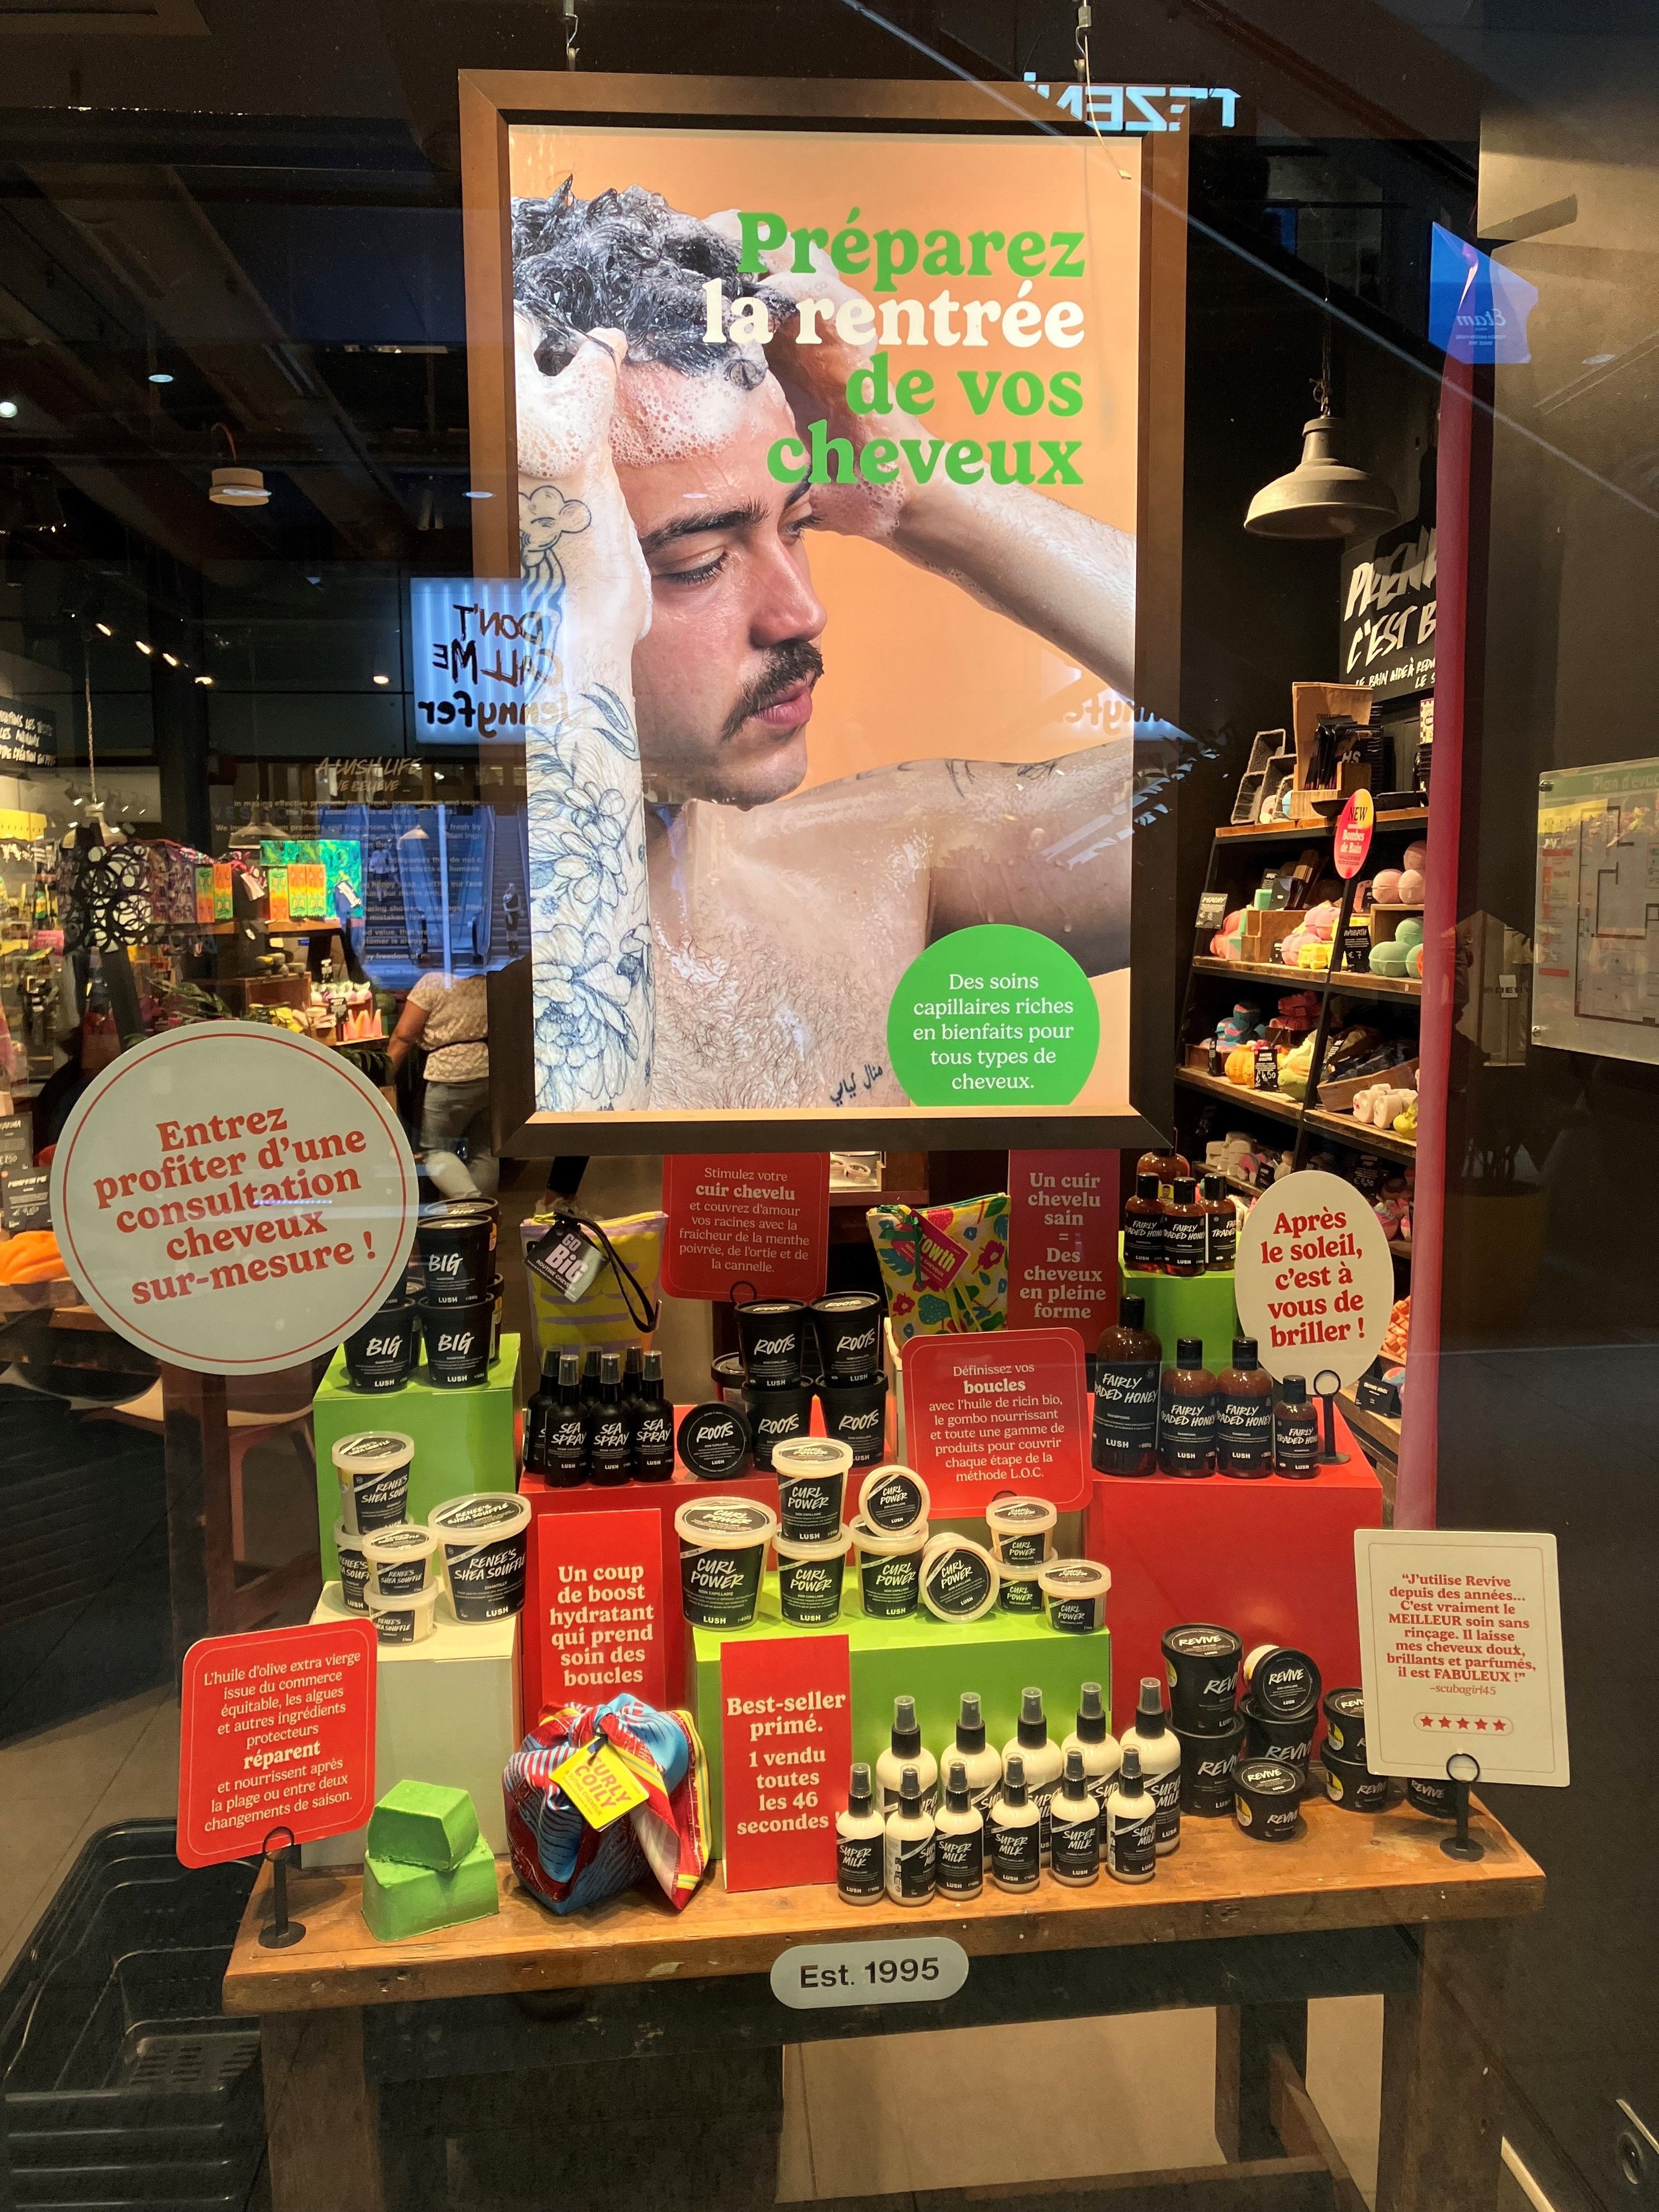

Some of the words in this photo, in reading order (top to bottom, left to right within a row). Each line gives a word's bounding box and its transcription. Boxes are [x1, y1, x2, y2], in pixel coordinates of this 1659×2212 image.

[737, 207, 1085, 292] Préparez
[702, 278, 774, 344] la
[796, 280, 1084, 347] rentrée
[846, 351, 935, 415] de
[957, 371, 1084, 416] vos
[767, 420, 1084, 484] cheveux
[1347, 606, 1418, 674] C'EST
[1348, 807, 1368, 821] NEW
[1342, 829, 1365, 842] Bombes
[1341, 842, 1348, 853] de
[1348, 842, 1362, 854] Bain
[949, 974, 984, 990] Des
[990, 973, 1039, 989] soins
[913, 998, 1010, 1019] capillaires
[1016, 997, 1074, 1014] riches
[913, 1028, 936, 1040] en
[942, 1023, 1023, 1040] bienfaits
[1029, 1025, 1074, 1043] pour
[931, 1050, 972, 1065] tous
[978, 1049, 1028, 1068] types
[1034, 1048, 1056, 1063] de
[952, 1074, 1034, 1090] cheveux.
[156, 1108, 287, 1152] Entrez
[93, 1153, 246, 1209] profiter
[258, 1131, 366, 1170] d'une
[705, 1168, 754, 1180] Stimulez
[758, 1172, 788, 1181] votre
[1030, 1173, 1056, 1188] Un
[1061, 1173, 1100, 1189] cuir
[696, 1183, 729, 1197] cuir
[734, 1185, 795, 1200] chevelu
[1027, 1192, 1101, 1208] chevelu
[117, 1168, 361, 1233] consultation
[704, 1205, 749, 1213] couvrez
[753, 1205, 801, 1216] d'amour
[1044, 1210, 1084, 1225] sain
[1273, 1206, 1347, 1238] Après
[167, 1210, 327, 1260] cheveux
[562, 1233, 582, 1252] GO
[1046, 1248, 1081, 1262] Des
[1261, 1242, 1283, 1264] le
[1290, 1233, 1362, 1261] soleil,
[428, 1252, 463, 1276] BIG
[712, 1259, 721, 1269] la
[725, 1261, 775, 1272] cannelle.
[131, 1243, 354, 1304] sur-mesure
[1024, 1266, 1103, 1282] cheveux
[1275, 1267, 1331, 1290] c'est
[1338, 1261, 1353, 1284] à
[1020, 1287, 1042, 1299] en
[1048, 1286, 1106, 1302] pleine
[1033, 1303, 1091, 1319] forme
[1267, 1297, 1327, 1319] vous
[1334, 1290, 1364, 1313] de
[836, 1328, 875, 1353] ROOTS
[1270, 1319, 1351, 1348] briller
[366, 1335, 403, 1357] BIG
[753, 1334, 796, 1355] ROOTS
[953, 1365, 1012, 1376] Définissez
[1015, 1364, 1035, 1373] vos
[963, 1378, 1026, 1394] boucles
[1103, 1373, 1142, 1389] FAIRLY
[929, 1402, 955, 1411] avec
[958, 1399, 992, 1410] l'huile
[995, 1398, 1009, 1407] de
[1013, 1396, 1038, 1406] ricin
[1042, 1395, 1062, 1405] bio,
[1124, 1389, 1158, 1404] HONEY
[559, 1422, 581, 1434] SEA
[551, 1431, 587, 1446] SPRAY
[1106, 1439, 1129, 1448] LUSH
[956, 1469, 1007, 1482] méthode
[1011, 1468, 1044, 1479] L.O.C.
[791, 1487, 823, 1499] CURL
[788, 1497, 830, 1510] POWER
[469, 1548, 517, 1570] RENEE'S
[697, 1558, 737, 1573] CURL
[454, 1567, 484, 1581] SHEA
[558, 1566, 587, 1583] Un
[593, 1566, 644, 1583] coup
[690, 1573, 745, 1589] POWER
[1465, 1576, 1511, 1587] Revive
[557, 1586, 582, 1604] de
[588, 1584, 645, 1602] boost
[1389, 1587, 1433, 1599] depuis
[1437, 1589, 1460, 1598] des
[550, 1605, 655, 1628] hydratant
[703, 1616, 726, 1624] LUSH
[1389, 1613, 1462, 1626] MEILLEUR
[1465, 1617, 1494, 1627] soin
[1498, 1619, 1529, 1628] sans
[551, 1627, 585, 1650] qui
[591, 1624, 653, 1647] prend
[1179, 1634, 1222, 1646] REVIVE
[561, 1648, 605, 1666] soin
[610, 1646, 645, 1663] des
[203, 1669, 245, 1686] L'huile
[248, 1663, 286, 1678] d'olive
[290, 1658, 322, 1672] extra
[325, 1652, 361, 1667] vierge
[564, 1667, 643, 1687] boucles
[1268, 1668, 1304, 1685] REVIVE
[1398, 1667, 1407, 1677] il
[1411, 1669, 1430, 1678] est
[1434, 1669, 1510, 1682] FABULEUX
[727, 1691, 846, 1716] Best-seller
[750, 1713, 823, 1742] primé.
[243, 1741, 321, 1770] réparent
[749, 1751, 758, 1767] 1
[763, 1747, 826, 1766] vendu
[587, 1756, 631, 1802] URLY
[756, 1772, 820, 1789] toutes
[759, 1793, 787, 1811] les
[792, 1792, 818, 1809] 46
[204, 1805, 290, 1833] changements
[294, 1799, 308, 1811] de
[312, 1792, 352, 1808] saison.
[737, 1815, 829, 1835] secondes
[995, 1833, 1029, 1850] SUPER
[998, 1843, 1024, 1857] MILK
[1003, 1874, 1019, 1882] LUSH
[800, 1964, 855, 1989] Est.
[864, 1957, 939, 1983] 1995
